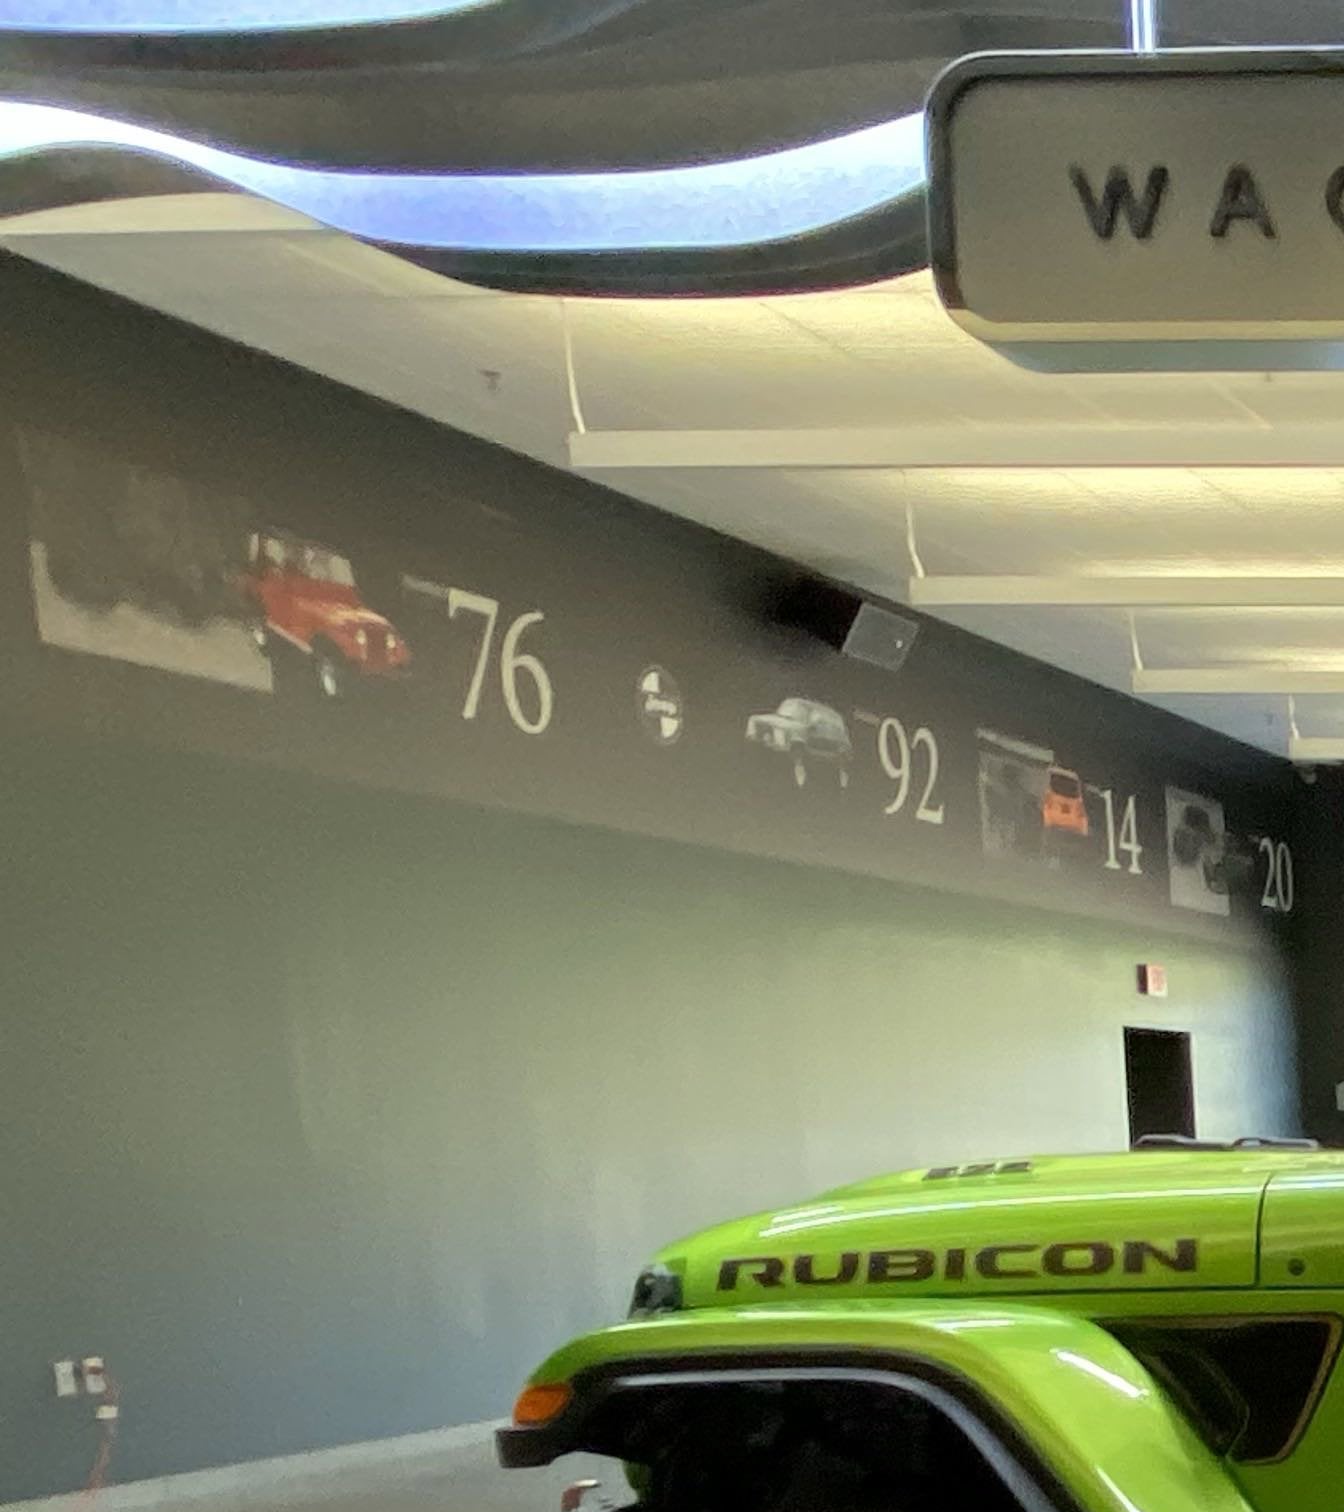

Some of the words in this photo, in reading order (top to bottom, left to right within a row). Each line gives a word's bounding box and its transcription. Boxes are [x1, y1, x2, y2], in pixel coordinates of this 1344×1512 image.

[448, 586, 552, 735] 76
[878, 717, 944, 824] 92
[1100, 789, 1143, 874] 14
[1259, 836, 1294, 912] 20
[716, 1239, 1197, 1291] RUBICON
